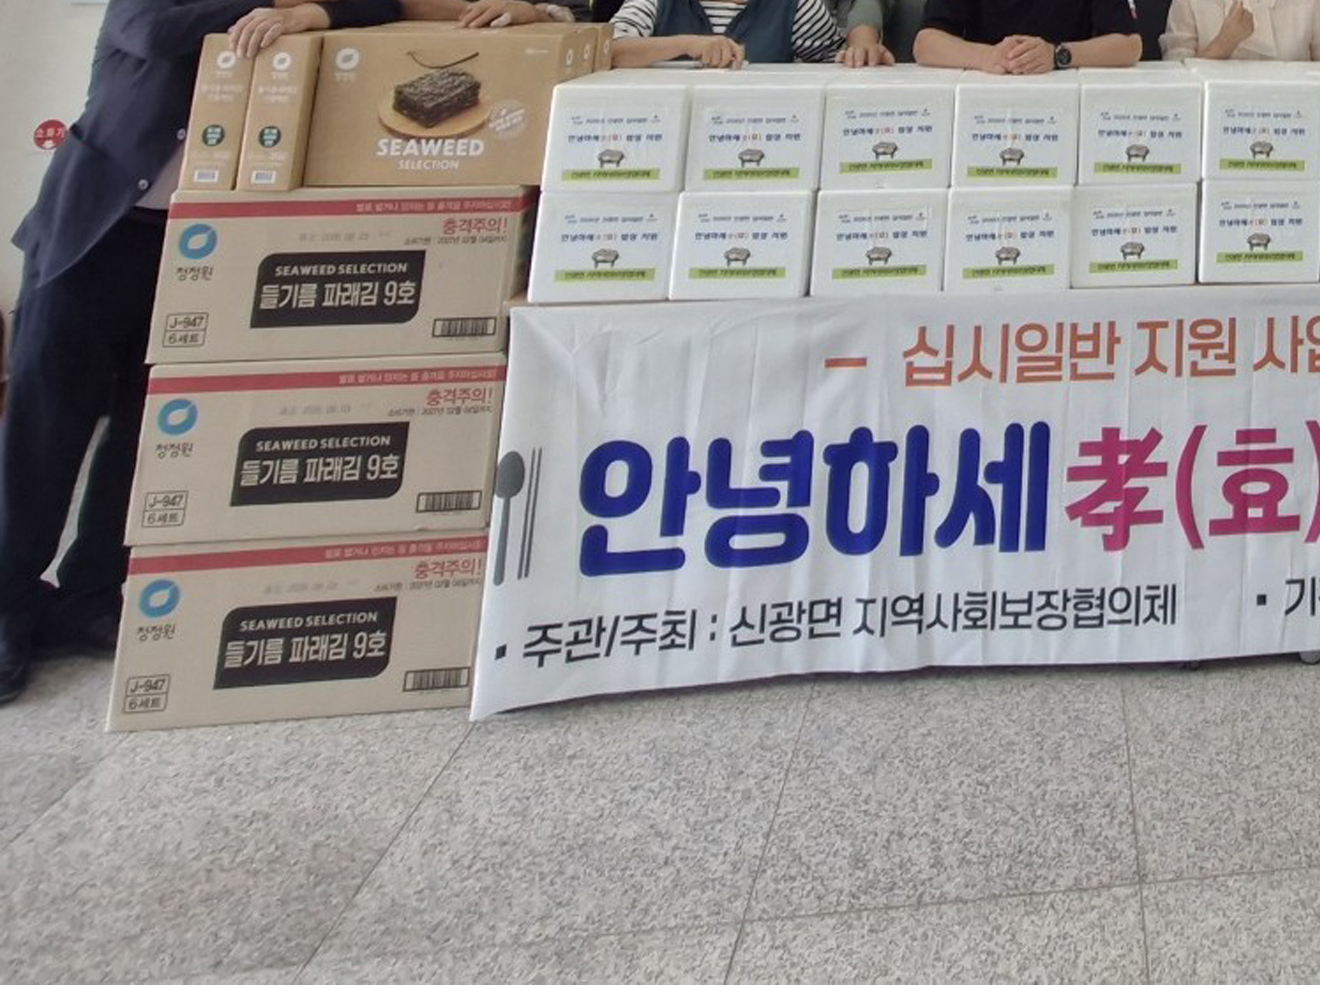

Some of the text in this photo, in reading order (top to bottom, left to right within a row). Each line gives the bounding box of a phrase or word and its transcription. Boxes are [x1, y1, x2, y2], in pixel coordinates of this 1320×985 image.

[376, 139, 484, 156] SEAWEED
[397, 159, 459, 170] SELECTION
[443, 217, 508, 235] 충격주의!
[174, 267, 213, 281] 청정원
[275, 263, 408, 276] SEAWEED SELECTION
[259, 279, 416, 309] 들기름 파래김 9호
[902, 317, 1121, 388] 십시일반
[1135, 316, 1238, 378] 지원
[426, 388, 493, 406] 충격주의!
[155, 442, 193, 459] 청정원
[256, 436, 391, 452] SEAWEED SELECTION
[240, 454, 400, 486] 들기름 파래김 9호
[414, 559, 482, 579] 충격주의!
[240, 612, 378, 632] SEAWEED SELECTION
[522, 607, 697, 668] 주관/주최
[728, 596, 843, 649] 신광면
[852, 582, 1177, 639] 지역사회보장협의체
[137, 624, 176, 642] 청정원
[224, 630, 387, 669] 들기름 파래김 9호
